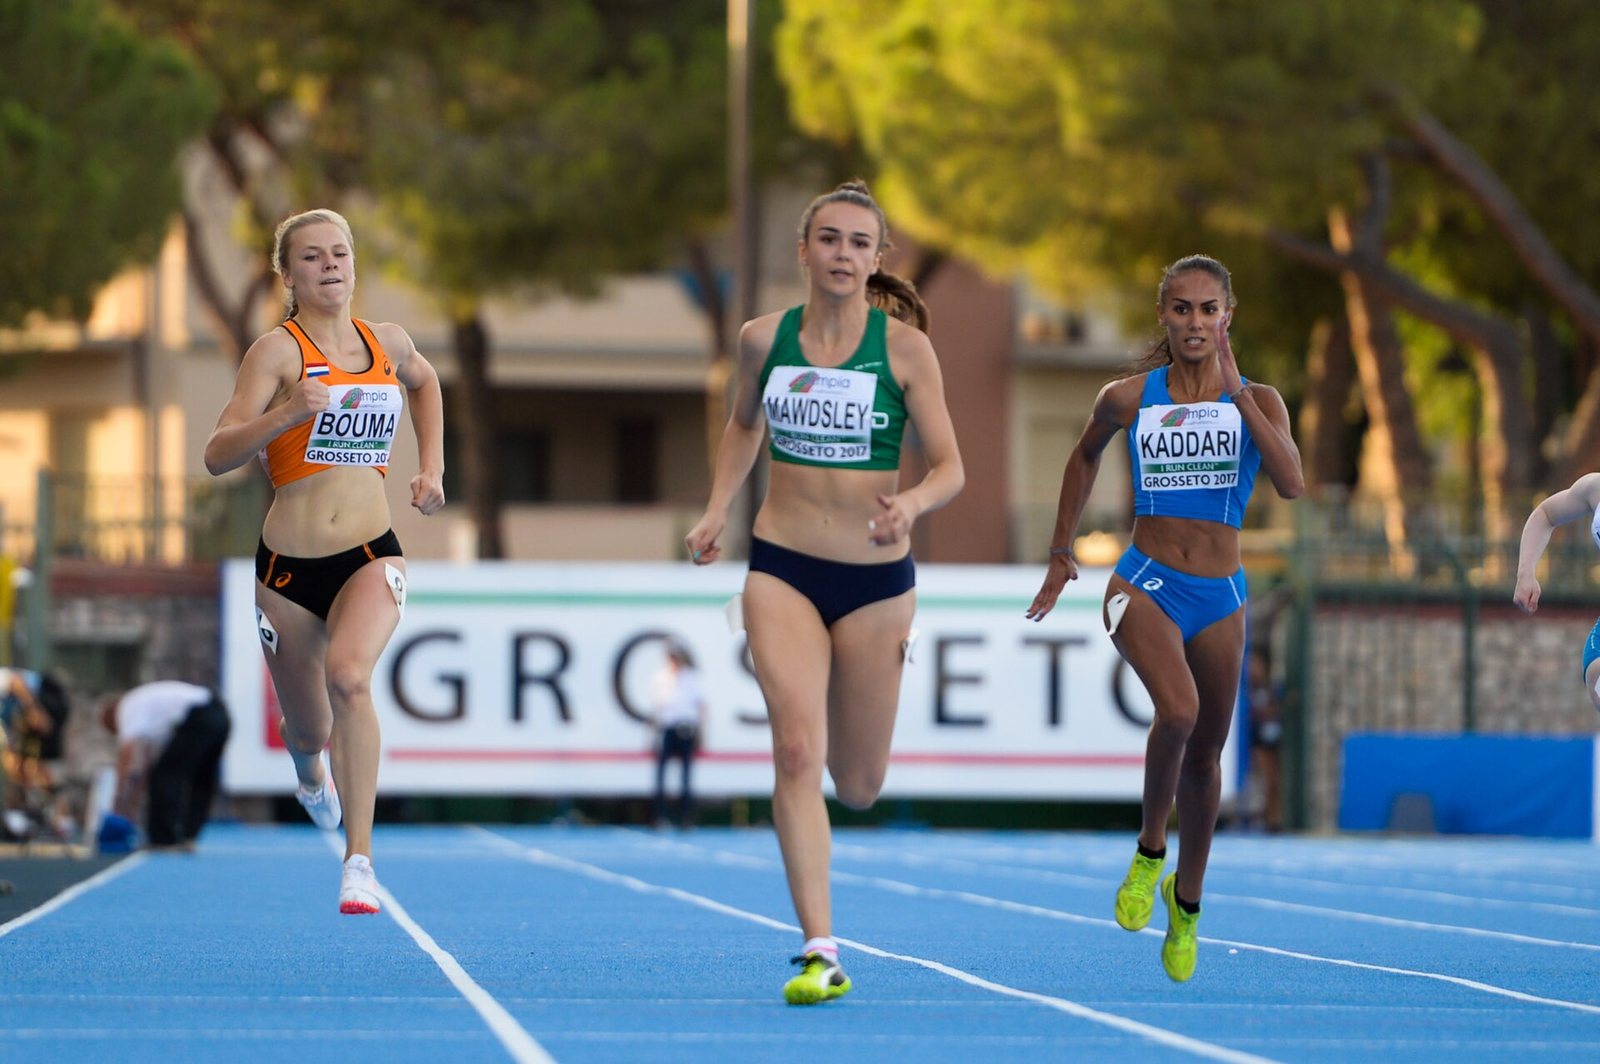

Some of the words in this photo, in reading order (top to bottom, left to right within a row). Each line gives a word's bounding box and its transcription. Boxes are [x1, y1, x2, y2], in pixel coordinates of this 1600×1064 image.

[767, 396, 869, 430] MAWDSLEY
[317, 412, 395, 438] BOUMA
[840, 445, 868, 458] 2017
[1141, 430, 1236, 459] KADDARI
[306, 449, 372, 463] GROSSETO
[1165, 463, 1185, 472] RUN
[1144, 474, 1211, 488] GROSSETO
[1214, 473, 1237, 485] 2017
